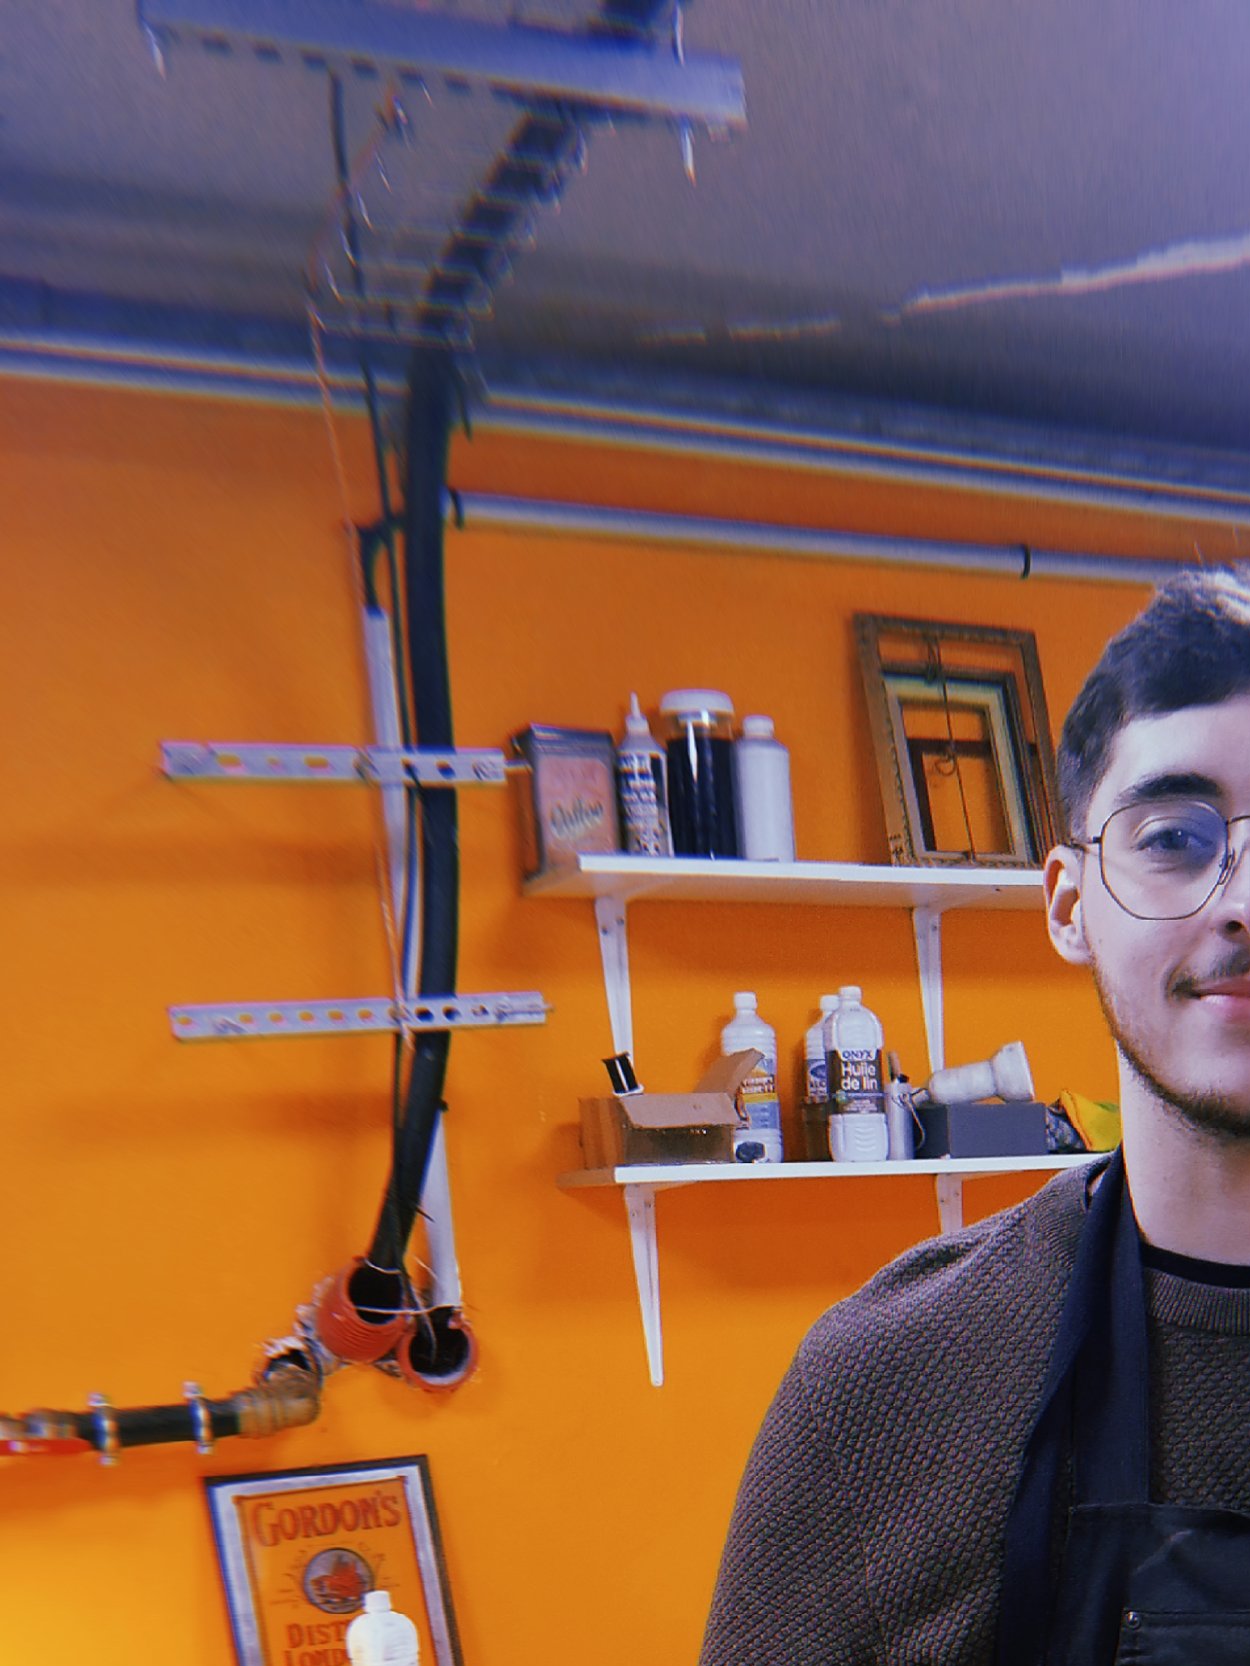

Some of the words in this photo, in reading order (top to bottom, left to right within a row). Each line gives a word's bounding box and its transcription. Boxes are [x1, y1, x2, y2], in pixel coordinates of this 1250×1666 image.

[842, 1050, 873, 1059] ONYX
[841, 1062, 876, 1077] Huile
[841, 1077, 860, 1091] de
[863, 1076, 878, 1091] lin
[254, 1490, 400, 1546] GORDON'S
